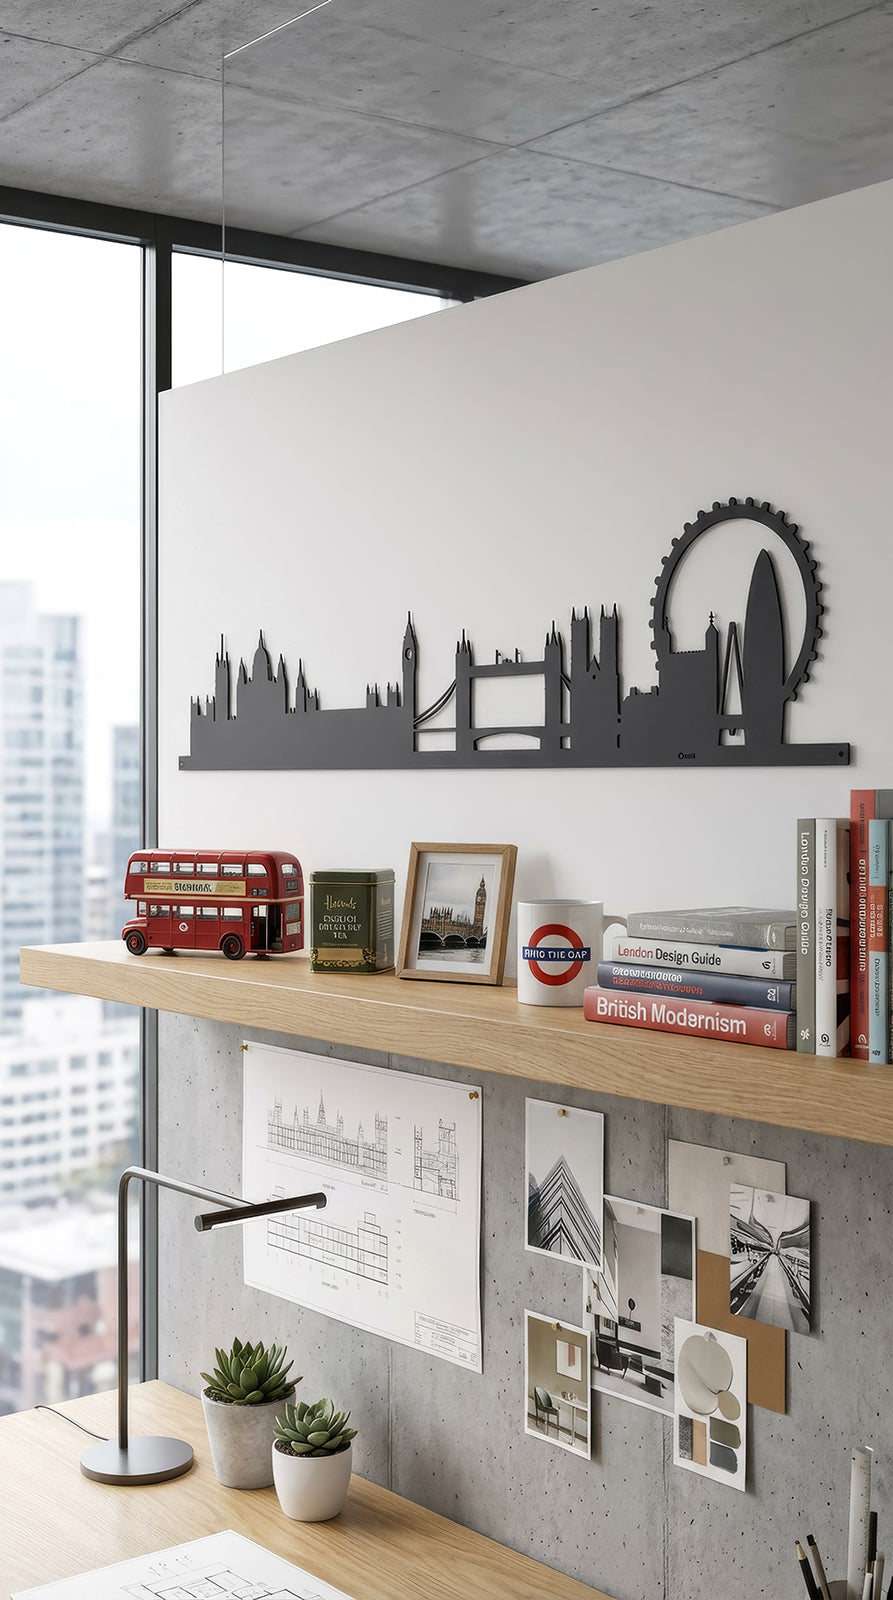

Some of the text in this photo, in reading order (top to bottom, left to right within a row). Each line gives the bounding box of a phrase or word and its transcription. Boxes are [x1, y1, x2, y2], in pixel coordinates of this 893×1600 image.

[655, 948, 689, 965] Design
[691, 951, 722, 966] Guide
[651, 1002, 747, 1036] Modernism
